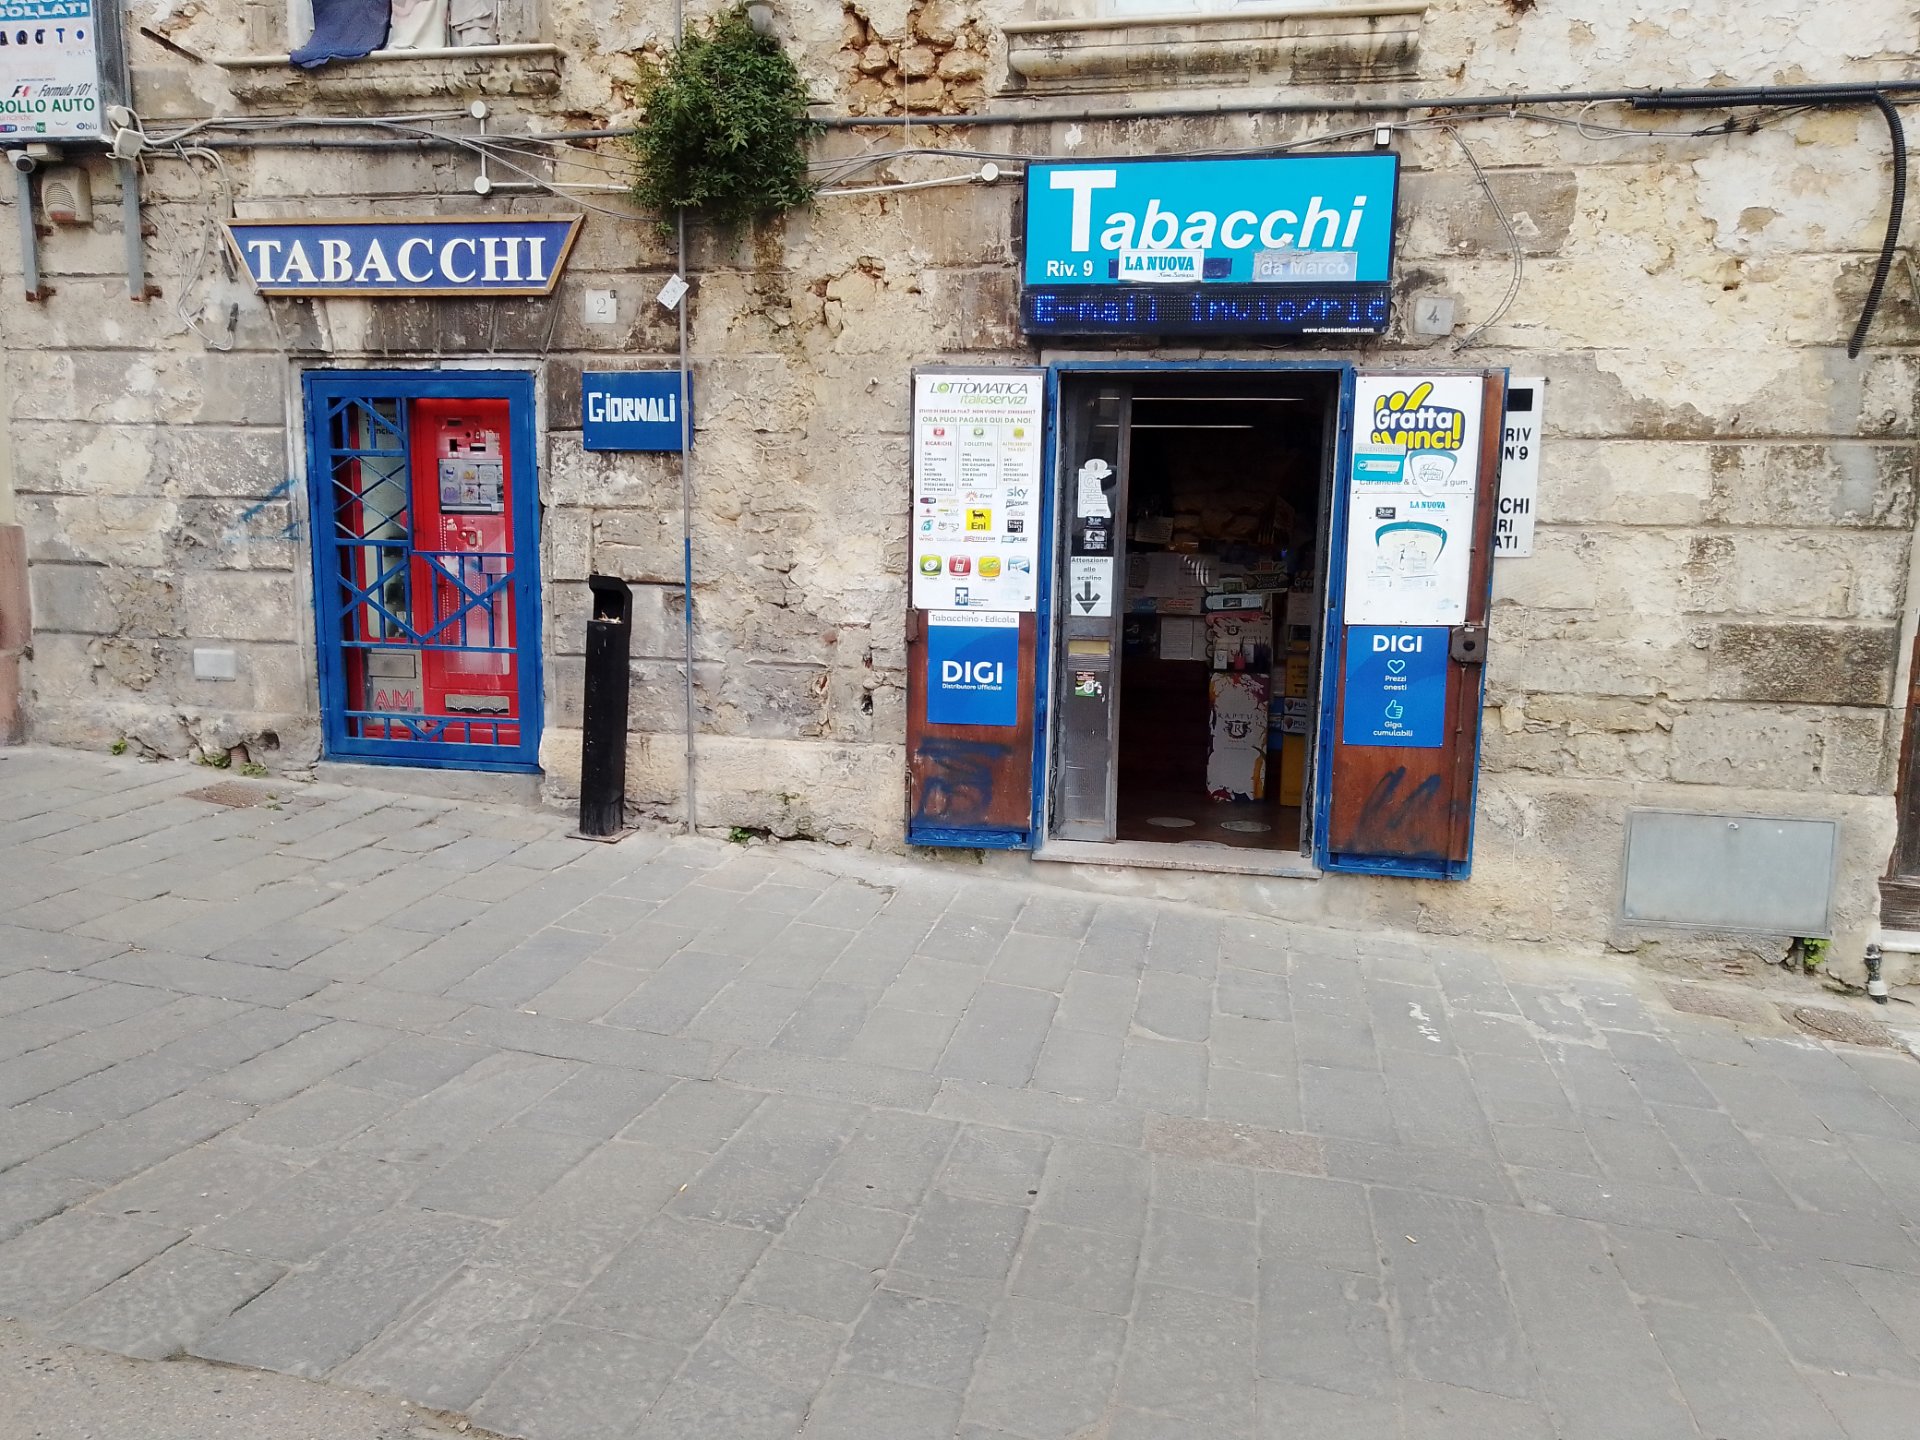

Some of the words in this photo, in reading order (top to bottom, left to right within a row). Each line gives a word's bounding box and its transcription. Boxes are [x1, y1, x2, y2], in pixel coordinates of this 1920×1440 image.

[38, 84, 74, 98] Formula
[74, 82, 93, 97] 101
[52, 98, 95, 112] AUTO
[1050, 169, 1367, 252] Tabacchi
[248, 237, 547, 283] TABACCHI
[1125, 257, 1144, 271] LA
[1147, 256, 1195, 271] NUOVA
[1261, 260, 1284, 276] da
[1290, 259, 1350, 276] Marco
[1046, 260, 1078, 277] Riv.
[1082, 261, 1094, 277] 9
[596, 297, 608, 315] 2
[1037, 295, 1158, 322] E-mail
[1426, 305, 1440, 324] 4
[930, 382, 1029, 395] LOTTOMATICA
[1375, 408, 1453, 430] Gratta
[1505, 427, 1532, 442] RIV
[1450, 479, 1468, 487] gum
[1007, 486, 1029, 499] sky
[1410, 501, 1419, 509] LA
[1421, 501, 1445, 509] NUOVA
[931, 614, 979, 622] Tabacchino
[985, 615, 1016, 624] Edicola
[1372, 634, 1423, 653] DIGI
[942, 660, 1003, 684] DIGI
[942, 682, 977, 691] Distributore
[1372, 729, 1413, 737] cumulabili
[1384, 721, 1403, 730] Giga
